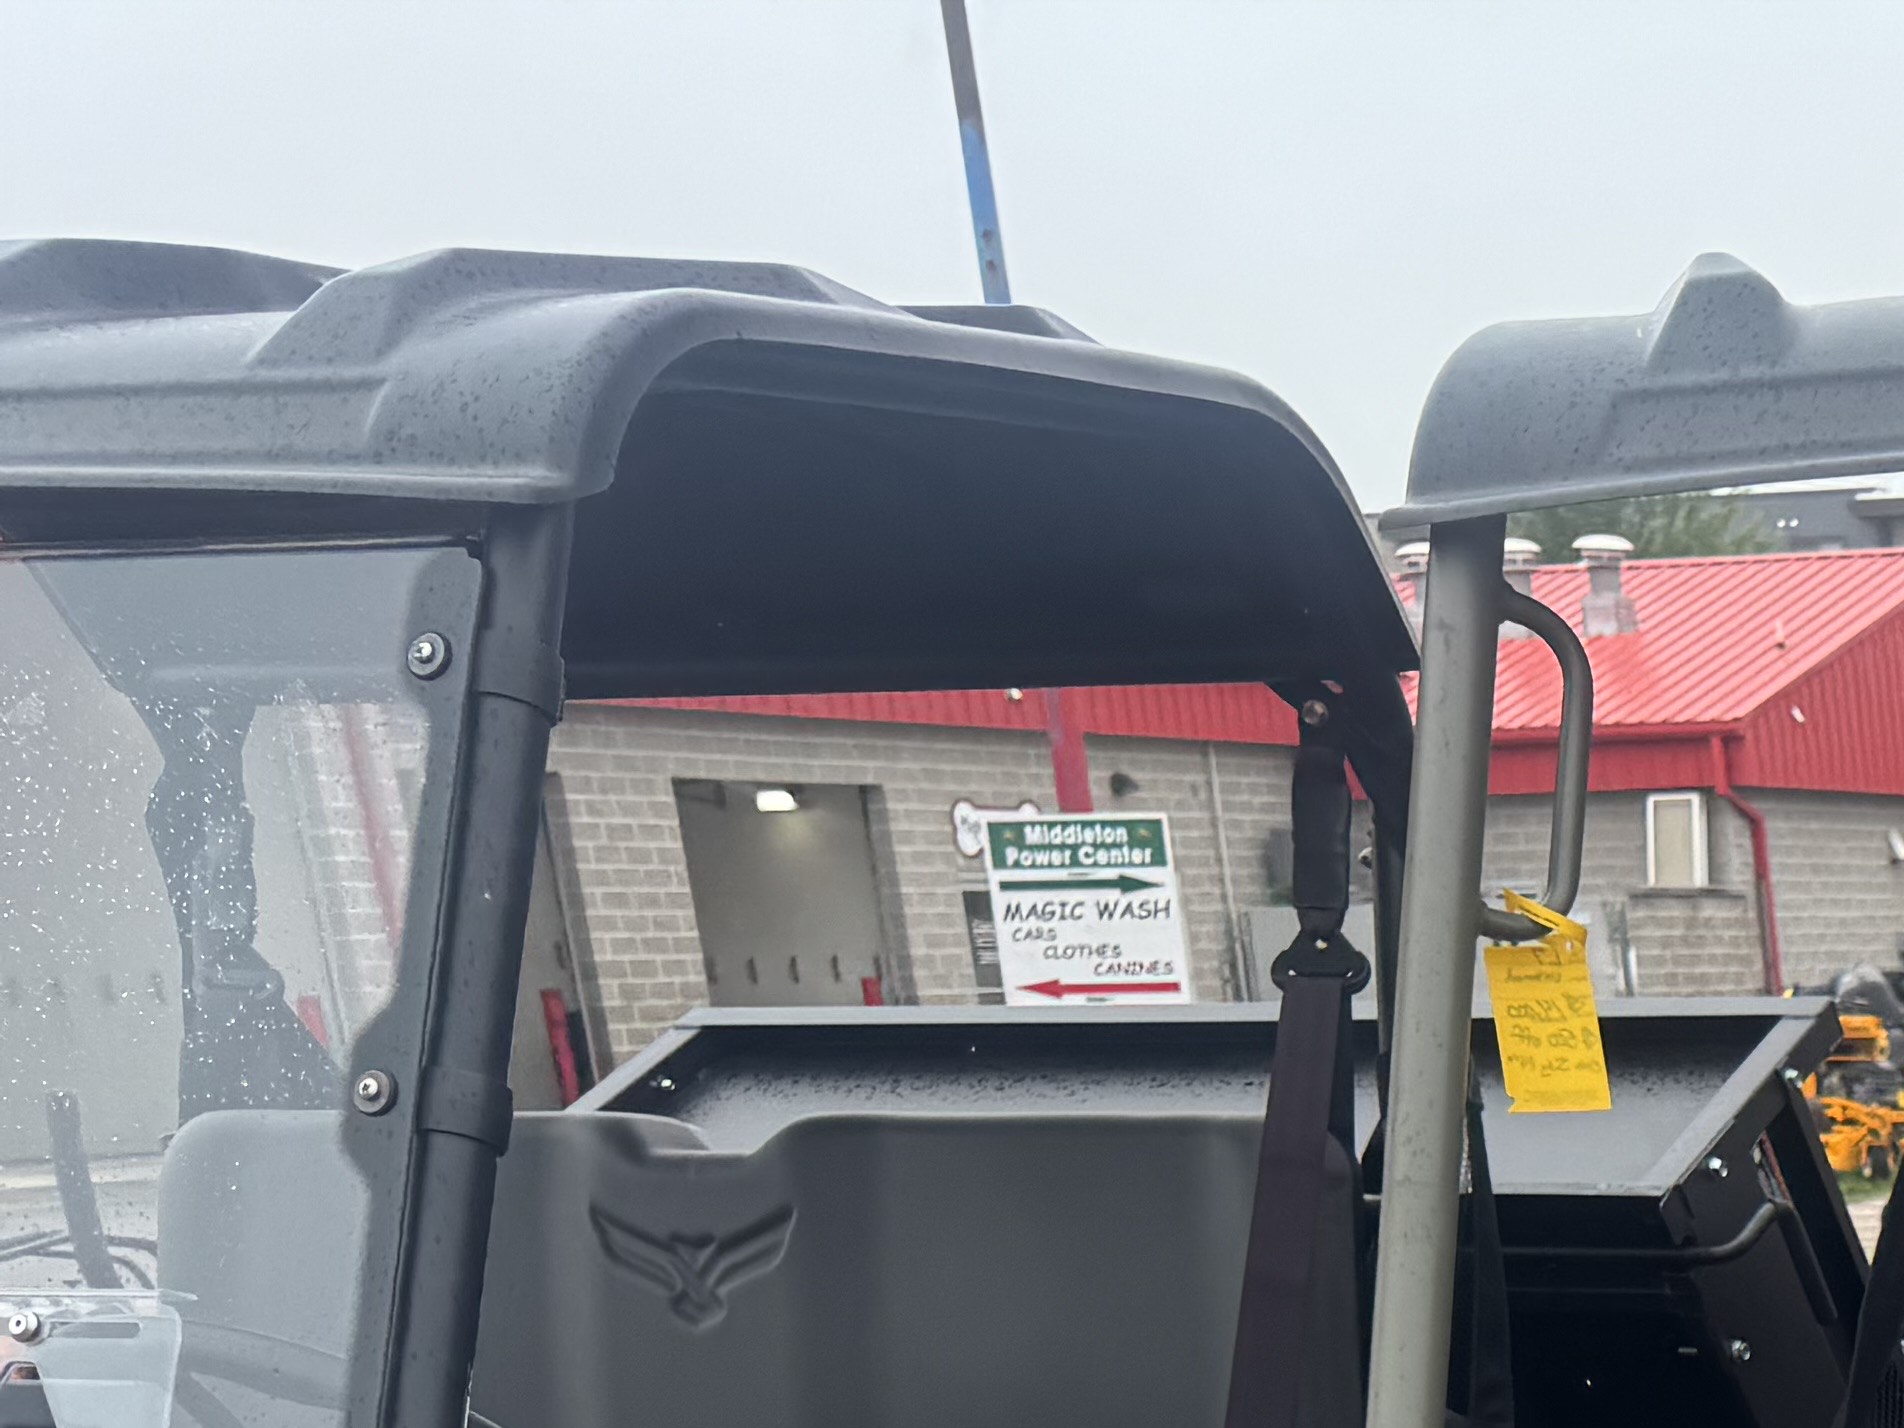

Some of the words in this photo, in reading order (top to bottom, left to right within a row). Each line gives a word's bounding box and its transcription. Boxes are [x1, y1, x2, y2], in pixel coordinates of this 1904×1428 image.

[1024, 825, 1128, 846] Middleton
[1005, 847, 1071, 867] Power
[1079, 845, 1153, 865] Center
[1003, 900, 1084, 923] MAGIC
[1095, 898, 1171, 921] WASH
[1011, 927, 1057, 942] CARS
